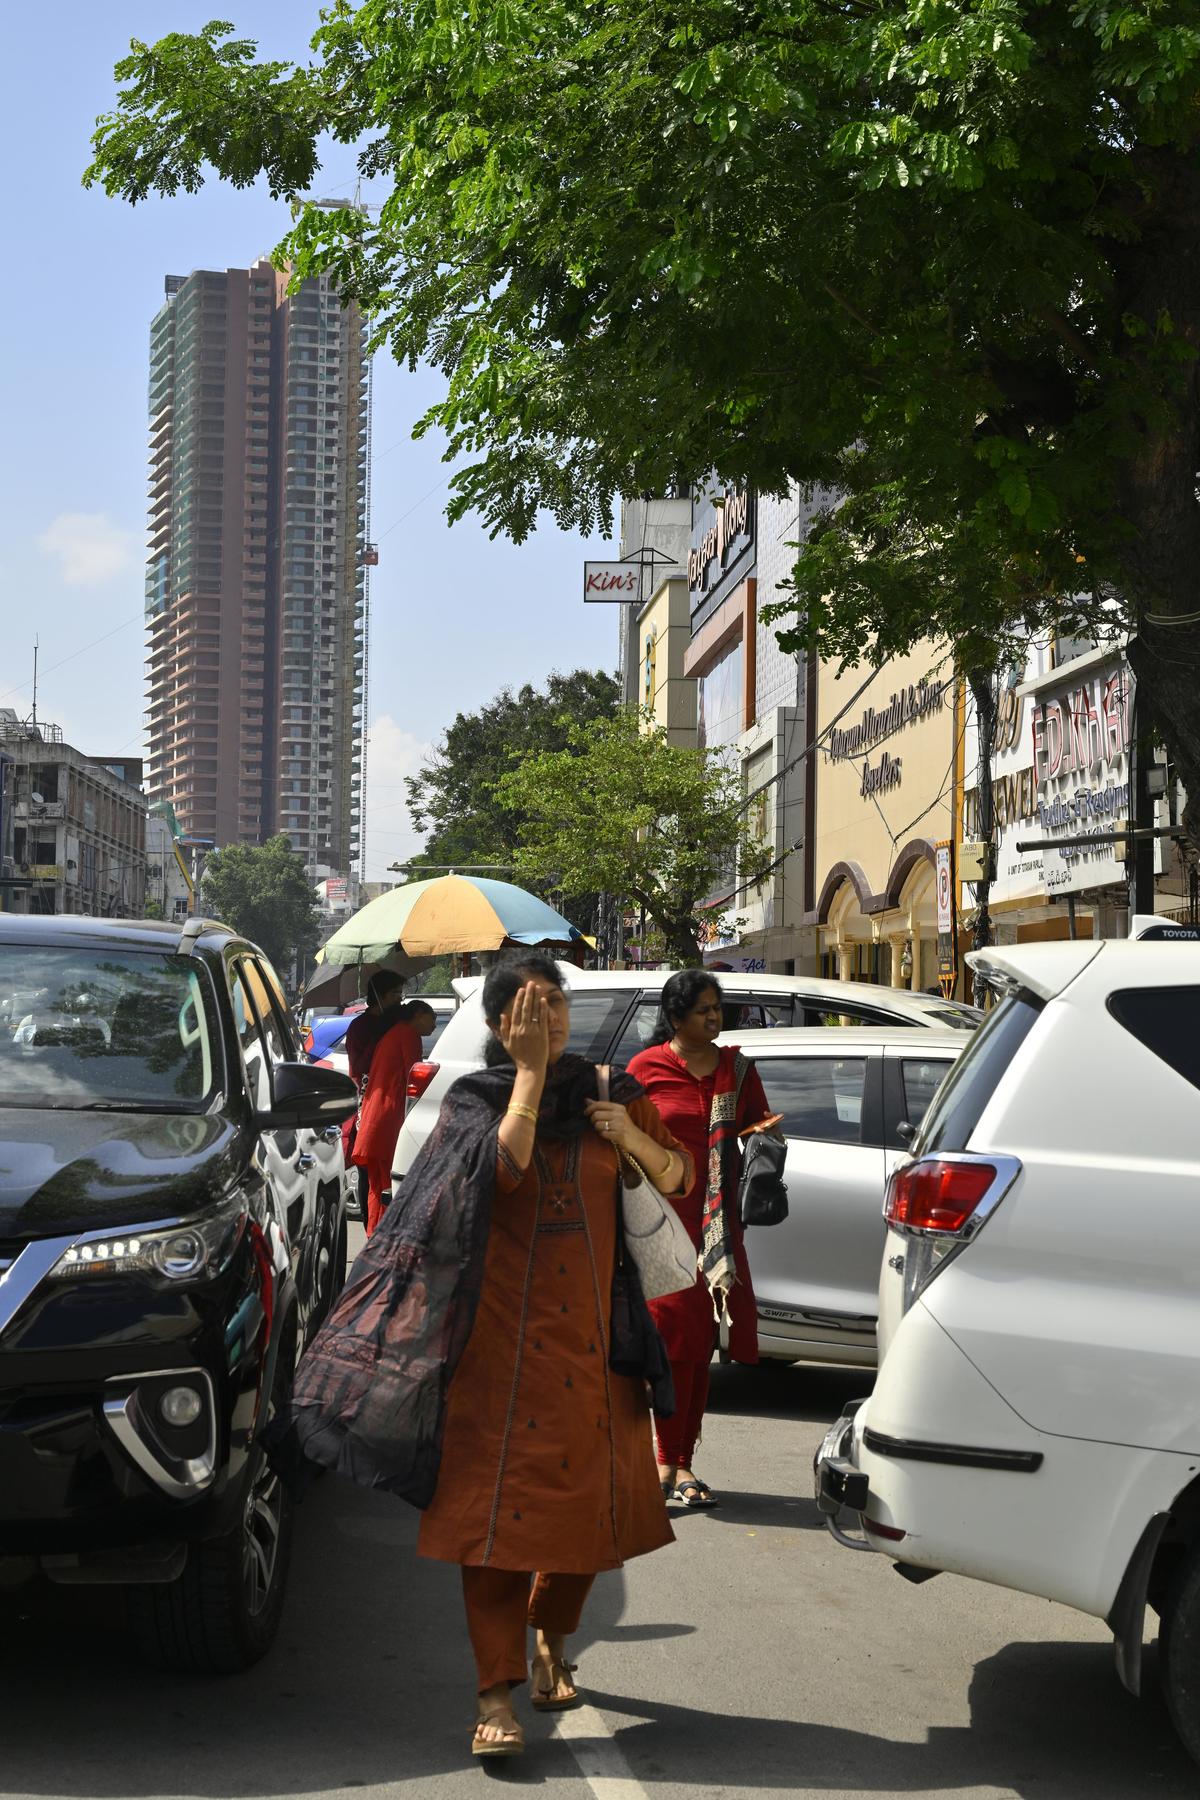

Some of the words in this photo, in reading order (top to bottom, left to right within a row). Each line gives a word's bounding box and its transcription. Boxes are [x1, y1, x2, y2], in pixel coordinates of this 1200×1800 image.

[586, 570, 638, 593] Kin's
[860, 751, 902, 797] Jewellers
[1162, 929, 1198, 939] TOYOTA
[763, 1309, 796, 1319] SWIFT
